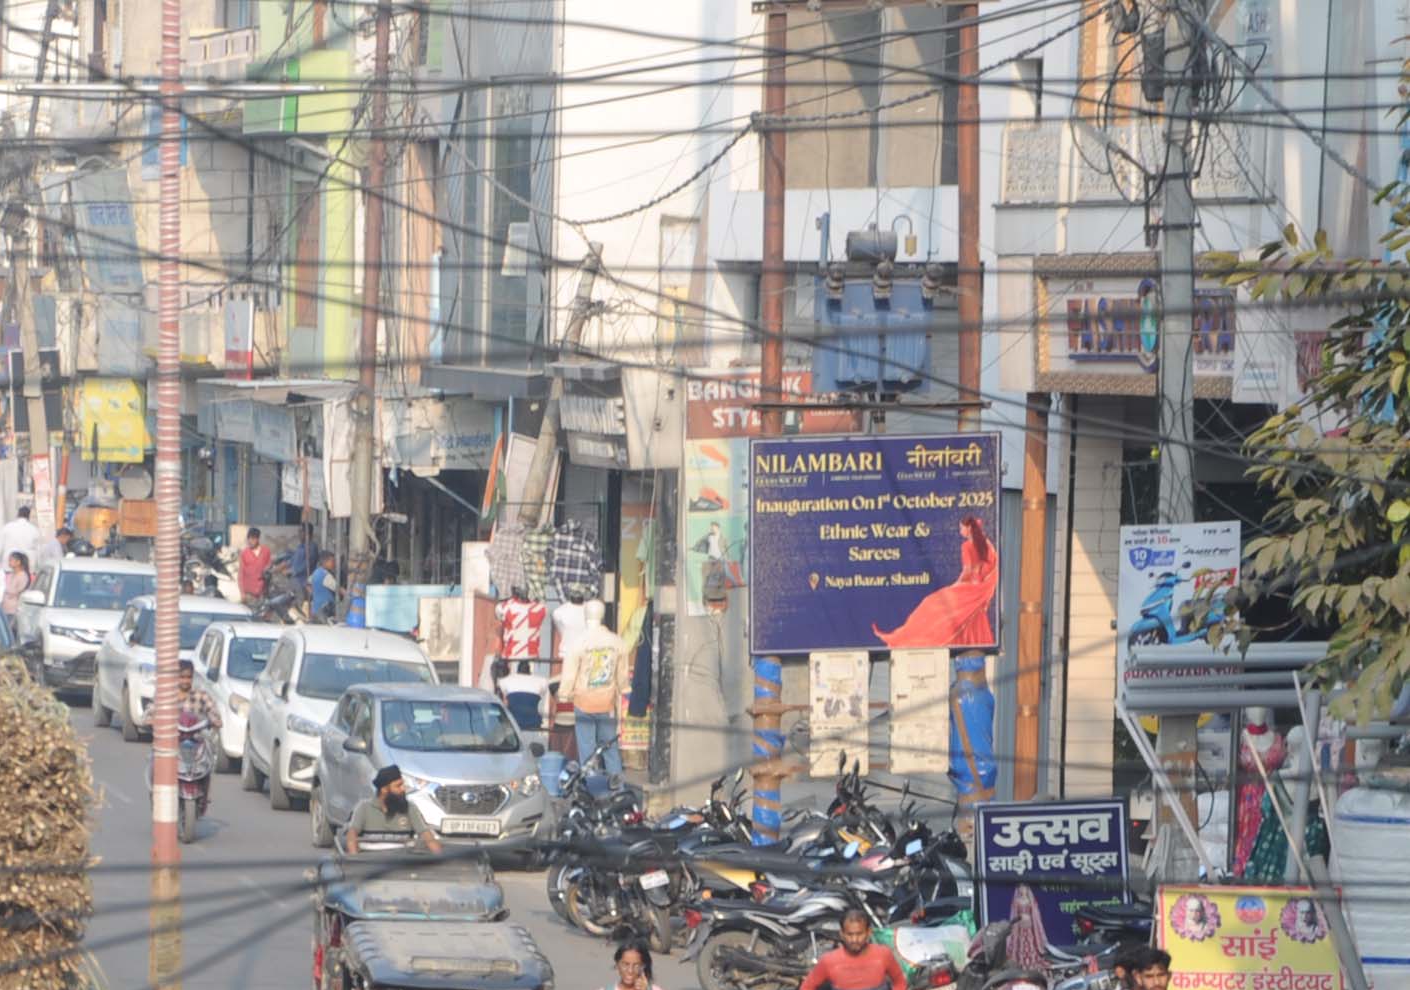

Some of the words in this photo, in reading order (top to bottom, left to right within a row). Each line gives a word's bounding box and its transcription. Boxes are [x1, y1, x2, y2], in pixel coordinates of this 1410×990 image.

[687, 375, 802, 401] BANGK
[711, 407, 763, 428] STYL
[756, 451, 882, 473] NILAMBARI
[906, 443, 982, 468] नीलांबरी
[756, 495, 849, 516] Inauguration
[851, 495, 875, 511] On
[893, 492, 956, 510] October
[958, 491, 993, 507] 2025
[819, 524, 867, 540] Ethnic
[870, 524, 911, 539] Wear
[914, 522, 931, 537] &
[848, 546, 901, 562] Sarees
[825, 575, 853, 590] Naya
[890, 572, 930, 587] Shamli
[991, 813, 1112, 848] उत्सव
[988, 850, 1033, 875] साड़ी
[1038, 848, 1068, 871] एवं
